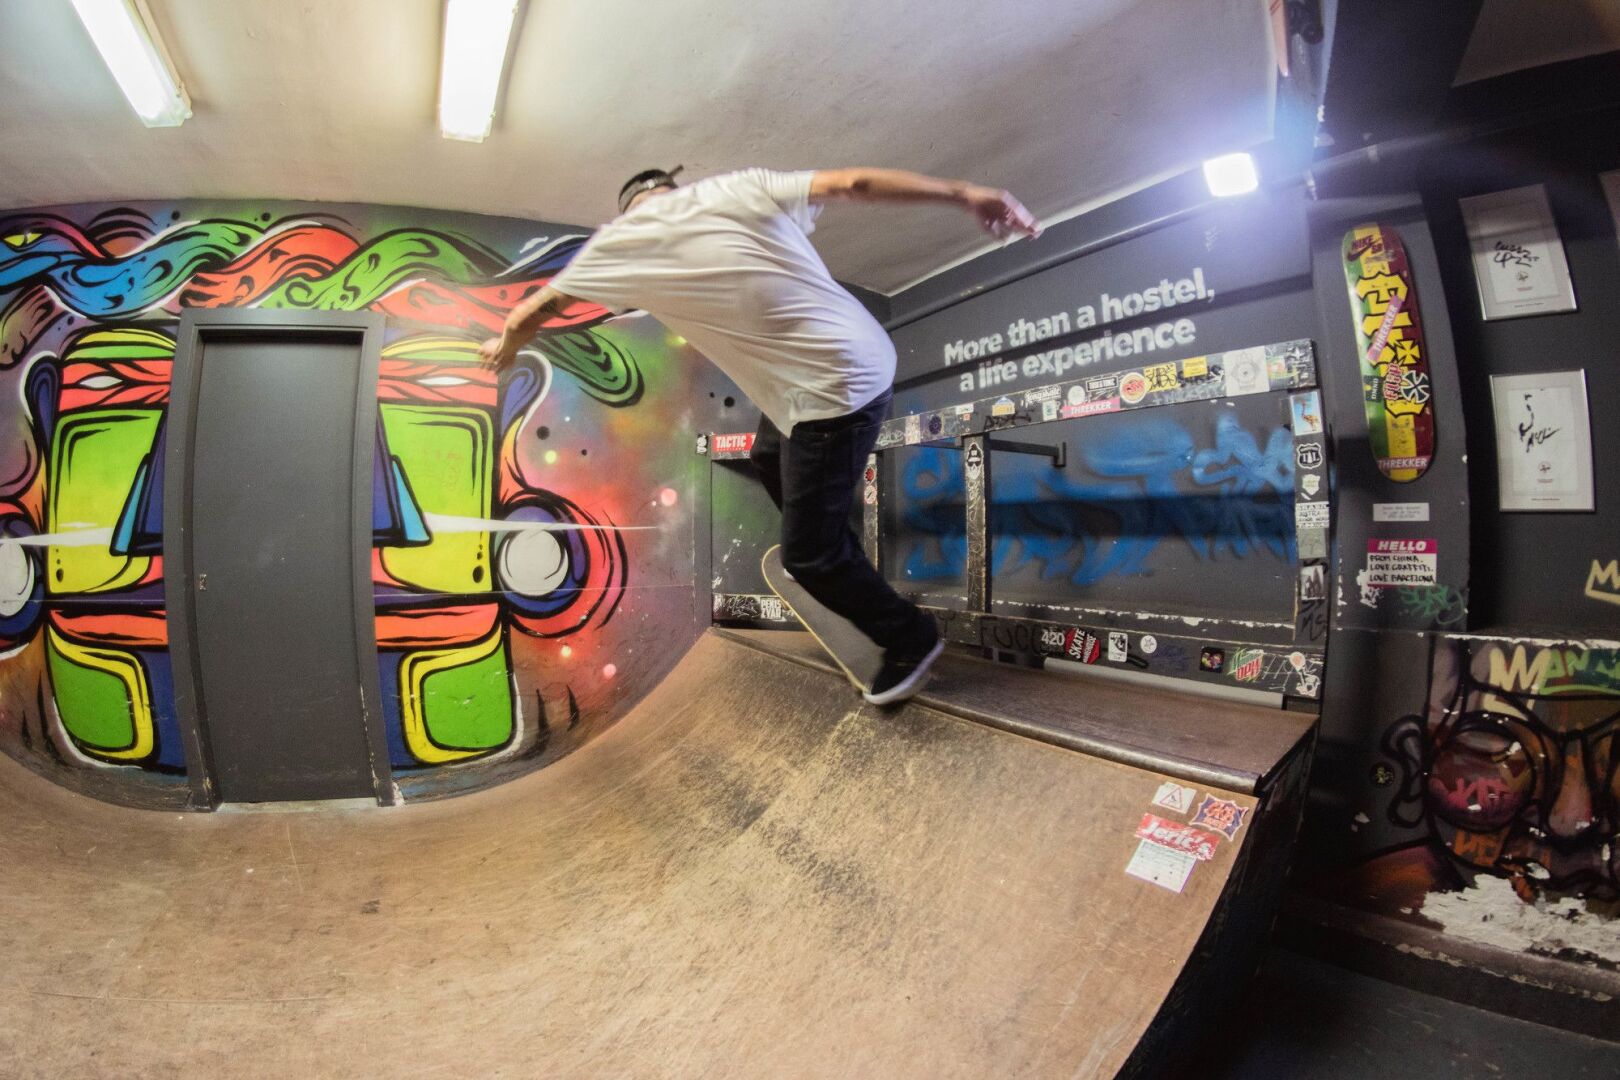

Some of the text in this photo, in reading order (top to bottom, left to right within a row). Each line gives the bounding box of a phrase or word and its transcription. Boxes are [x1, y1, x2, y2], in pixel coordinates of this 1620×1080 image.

[944, 267, 1215, 366] More than a hostel,
[960, 372, 974, 392] a
[979, 358, 1017, 389] life
[1022, 318, 1196, 377] experience
[716, 435, 746, 449] TACTIC
[1378, 458, 1427, 469] THREKKER
[1378, 541, 1427, 552] HELLO
[1370, 574, 1388, 582] LOVE
[1041, 630, 1065, 646] 420
[1069, 628, 1086, 659] SKATE
